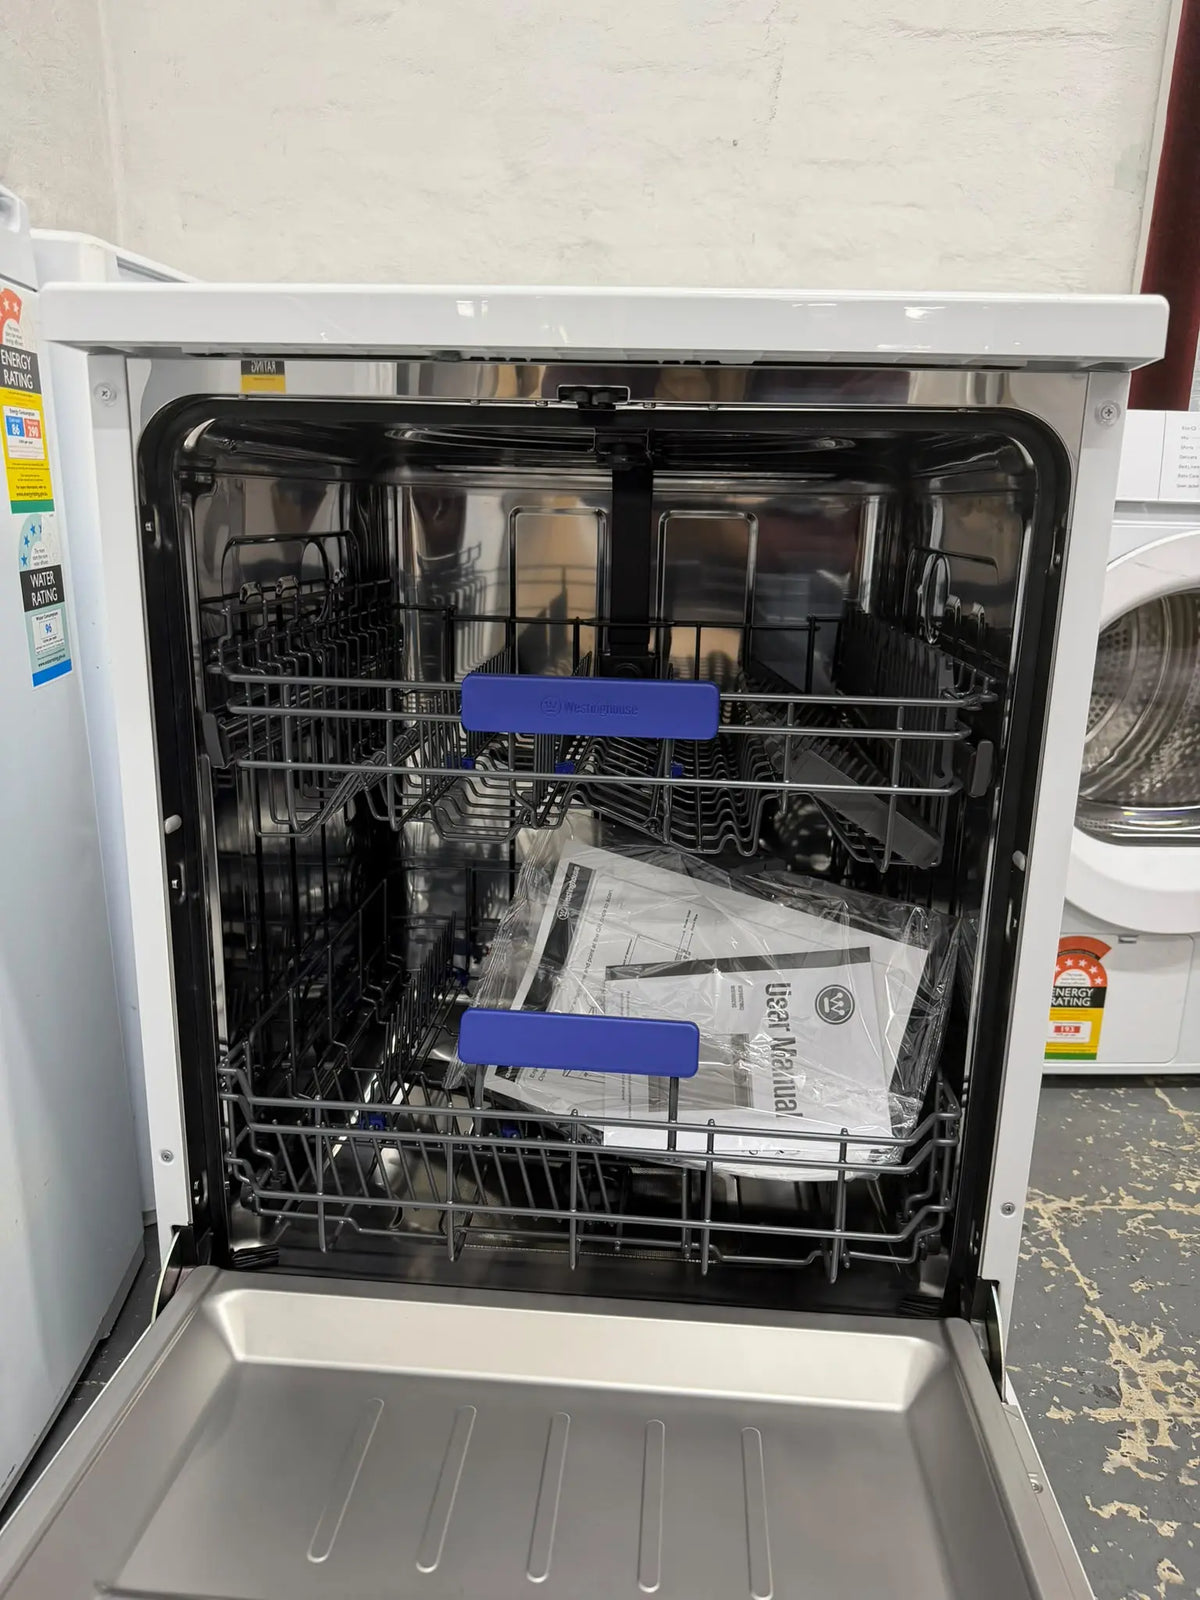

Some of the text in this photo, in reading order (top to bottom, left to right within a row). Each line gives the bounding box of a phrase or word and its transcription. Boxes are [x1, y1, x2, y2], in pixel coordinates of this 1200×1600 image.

[1, 351, 32, 370] ENERGY
[4, 371, 33, 389] RATING
[30, 571, 56, 588] WATER
[31, 588, 58, 607] RATING
[563, 700, 638, 717] Westinghouse
[563, 865, 581, 907] Westinghouse
[766, 983, 792, 1031] User
[770, 1037, 803, 1118] Manual
